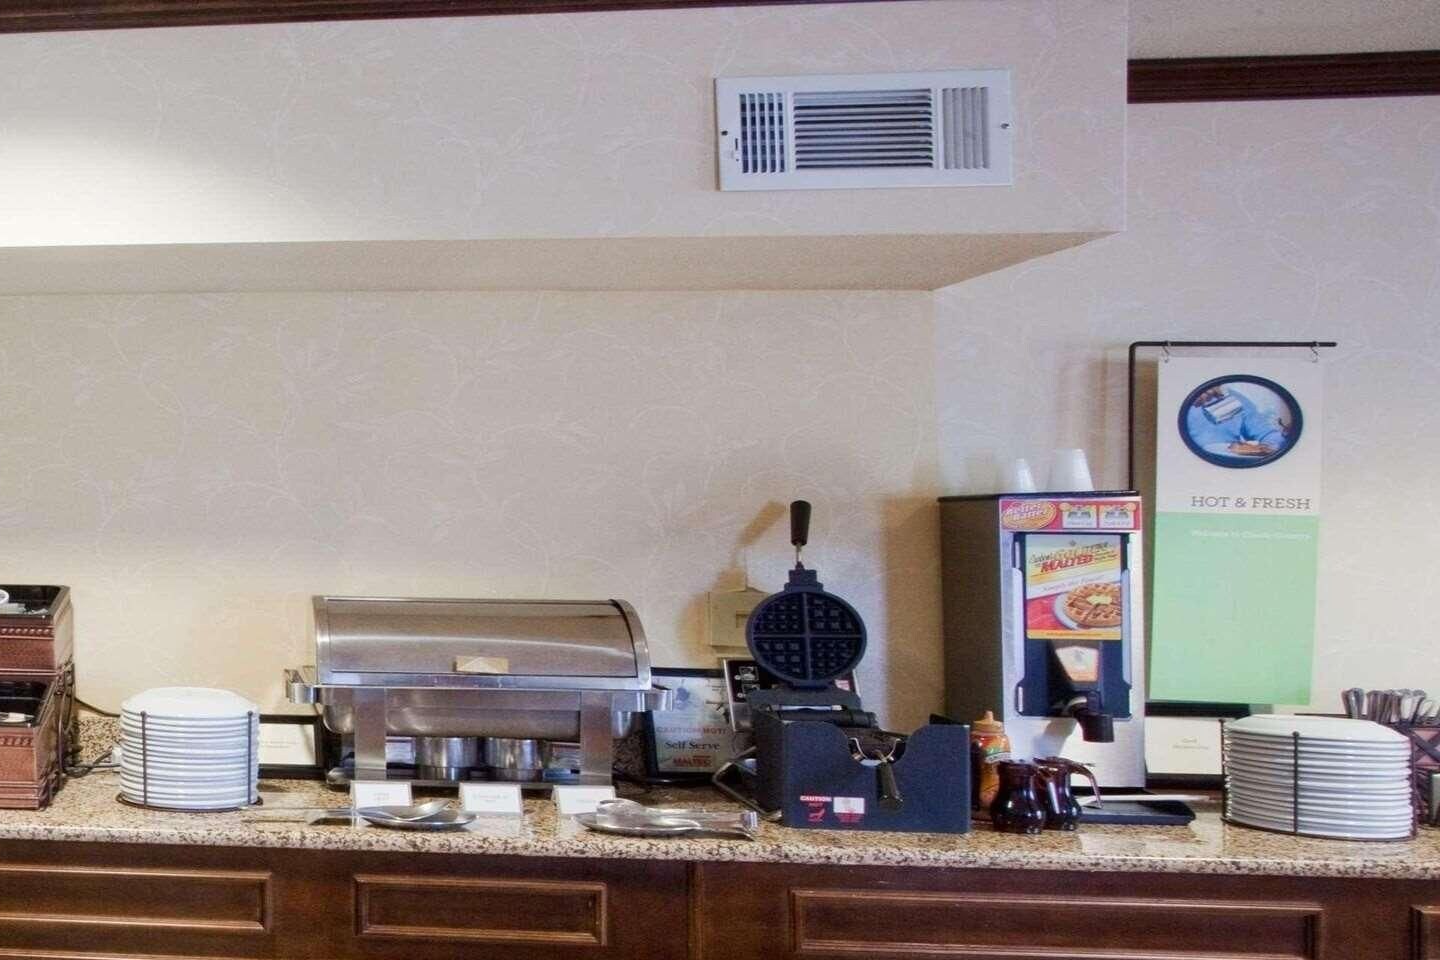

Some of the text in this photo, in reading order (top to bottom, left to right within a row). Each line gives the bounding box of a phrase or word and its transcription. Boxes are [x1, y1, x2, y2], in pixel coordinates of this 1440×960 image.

[1191, 496, 1311, 510] HOT & FRESH
[664, 740, 720, 751] Self Serve
